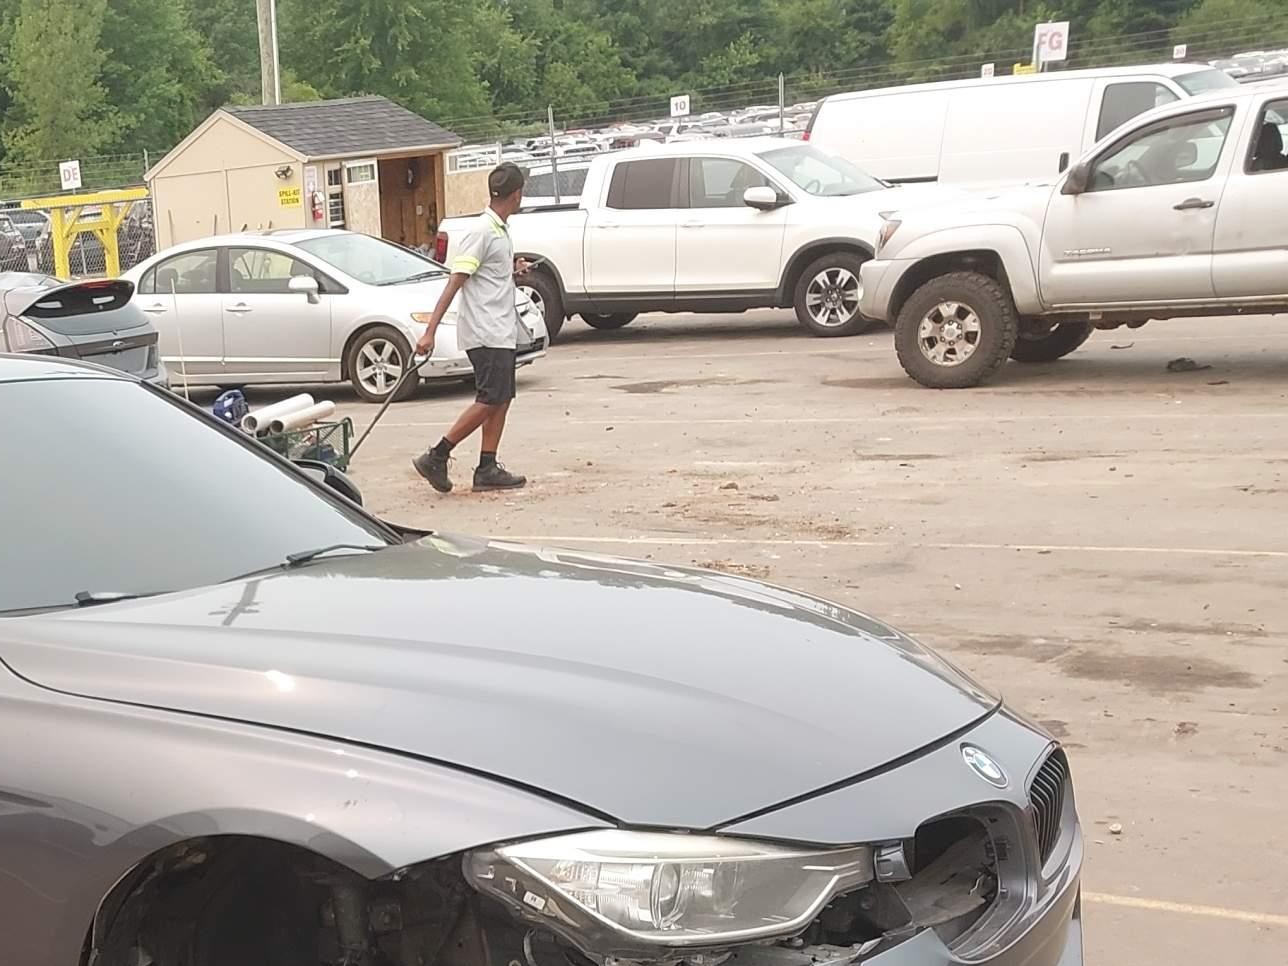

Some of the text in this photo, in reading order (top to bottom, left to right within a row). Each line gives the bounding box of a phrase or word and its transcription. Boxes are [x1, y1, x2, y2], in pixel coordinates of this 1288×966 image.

[1038, 31, 1063, 50] FG
[674, 100, 686, 112] 10
[63, 167, 79, 182] DE
[281, 197, 299, 205] STATION
